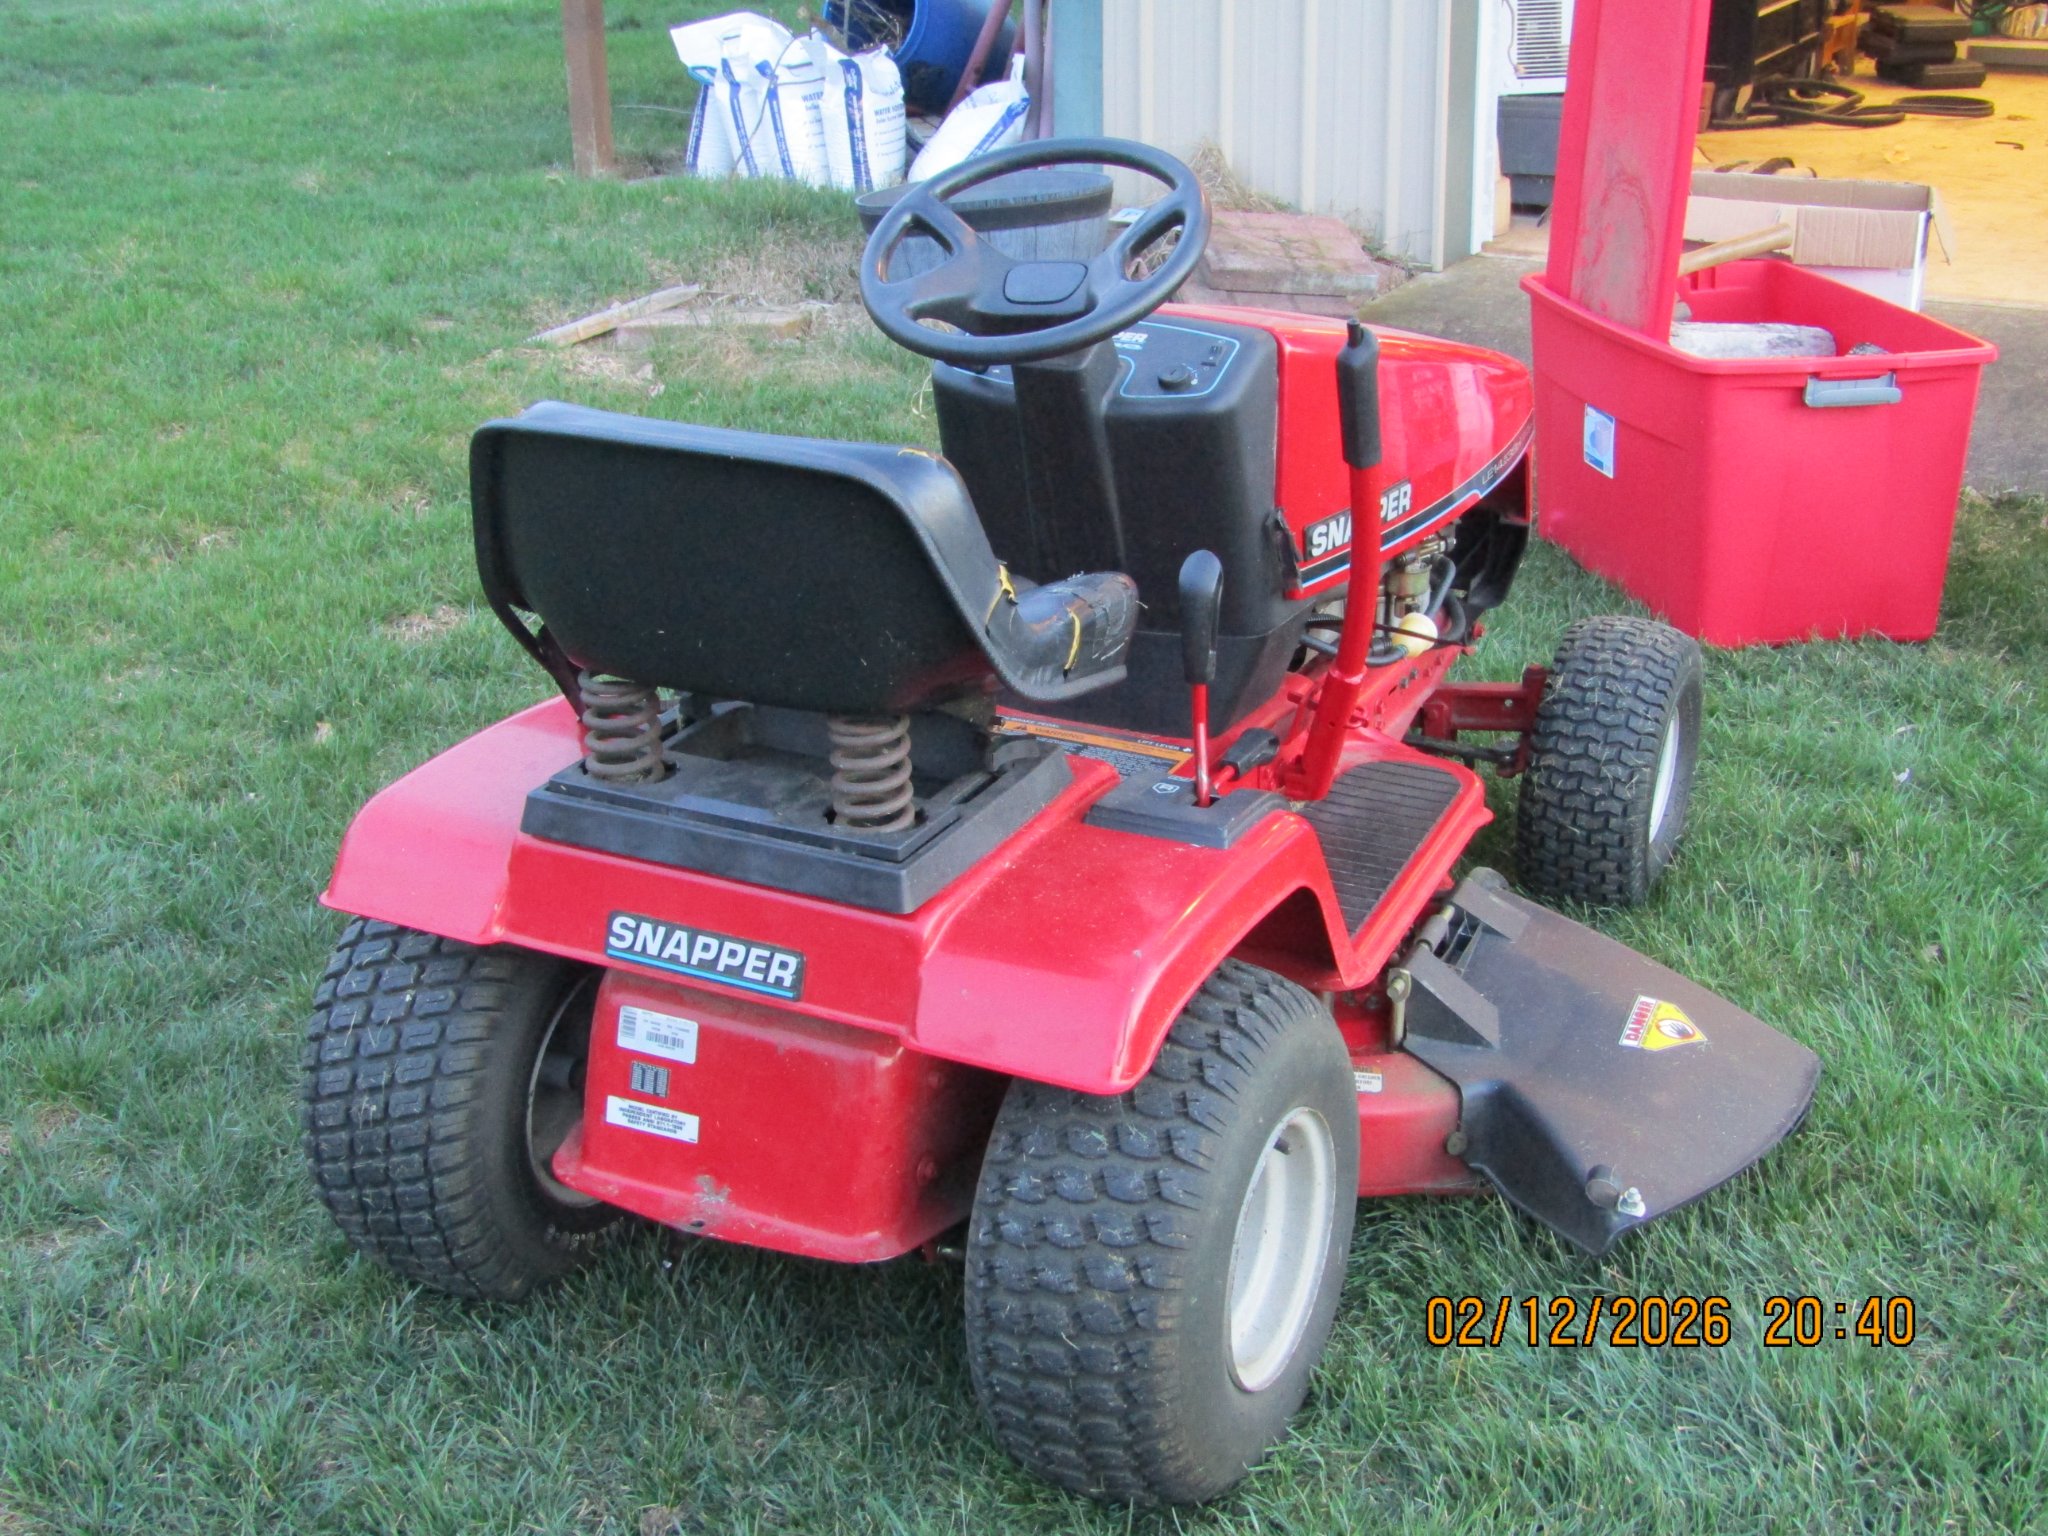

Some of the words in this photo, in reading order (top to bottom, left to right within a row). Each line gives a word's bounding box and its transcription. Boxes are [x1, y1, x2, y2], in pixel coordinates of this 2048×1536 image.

[1311, 483, 1412, 557] SNPER
[608, 916, 798, 987] SNAPPER
[1624, 1000, 1654, 1042] DANGER
